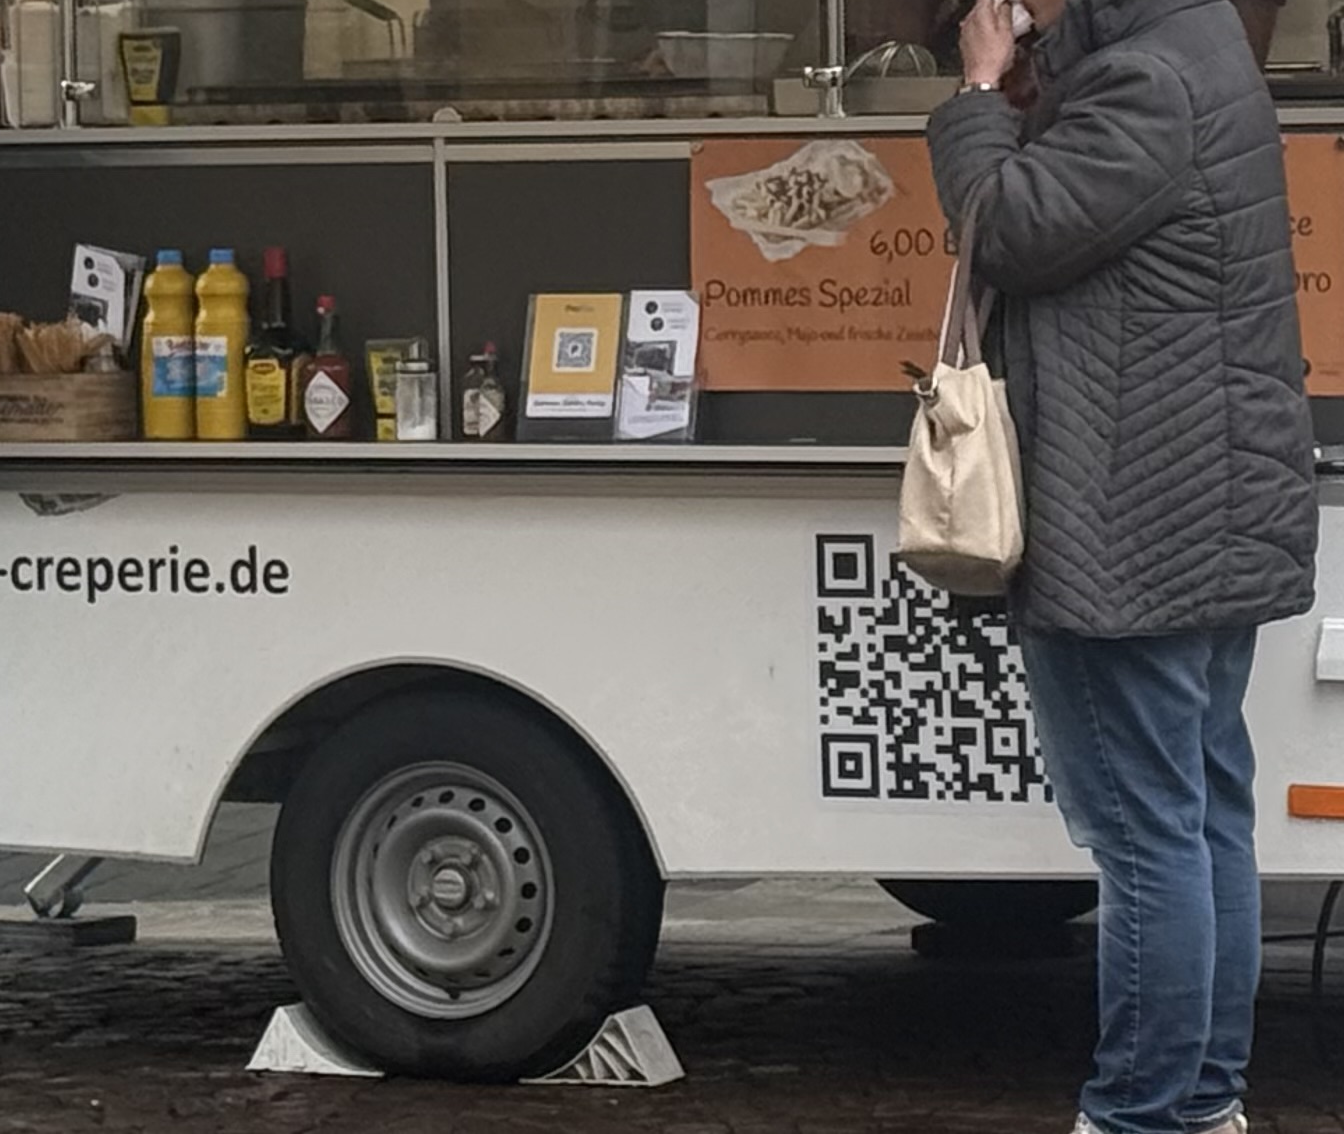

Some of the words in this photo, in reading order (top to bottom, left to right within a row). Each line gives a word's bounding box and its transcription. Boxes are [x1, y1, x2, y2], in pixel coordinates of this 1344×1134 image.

[869, 228, 935, 263] 6,00
[705, 278, 812, 308] Pommes
[818, 278, 913, 313] Spezial
